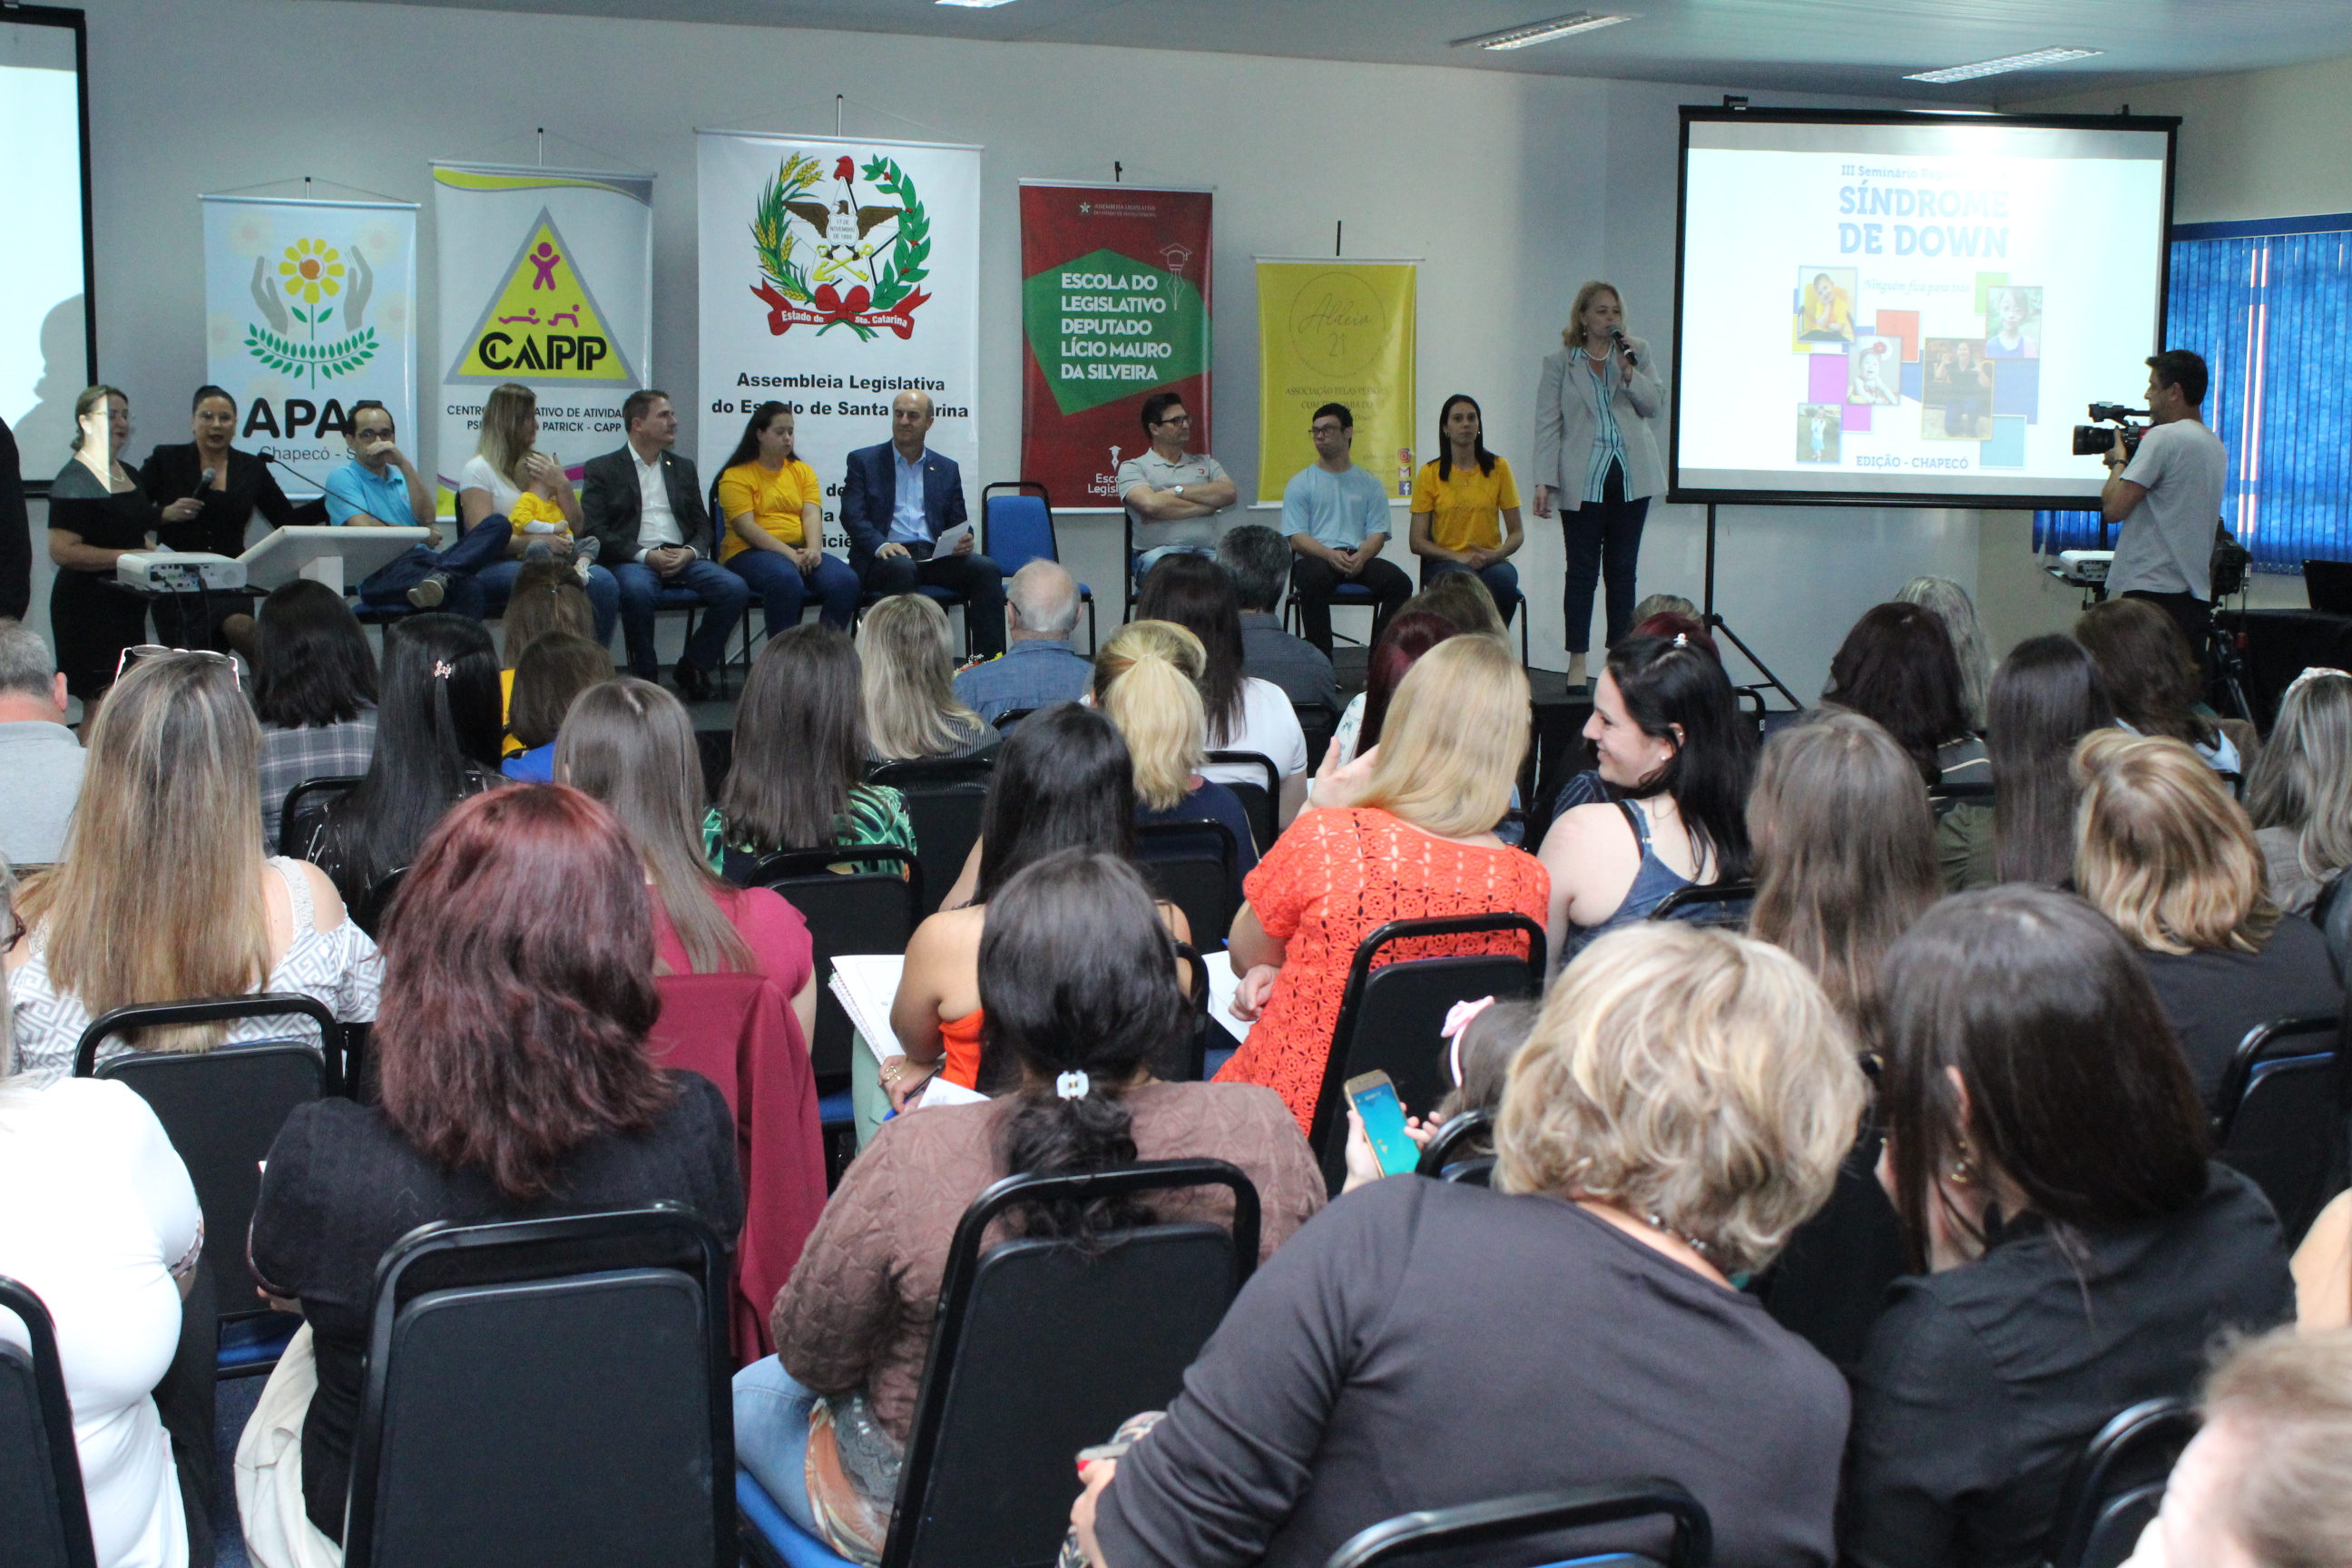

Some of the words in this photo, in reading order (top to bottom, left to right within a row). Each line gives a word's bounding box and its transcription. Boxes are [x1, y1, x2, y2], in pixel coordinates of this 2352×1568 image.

[1841, 165, 1855, 176] III
[1858, 165, 1917, 180] Seminário
[1839, 180, 2009, 218] SÍNDROME
[1838, 222, 1883, 254] DE
[1894, 224, 2009, 258] DOWN
[1062, 273, 1129, 289] ESCOLA
[1132, 275, 1158, 290] DO
[1862, 279, 1906, 294] Ninguém
[1906, 279, 1926, 295] fica
[1927, 282, 1949, 296] para
[1062, 296, 1166, 313] LEGISLATIVO
[1298, 292, 1372, 334] Aldeia
[781, 310, 811, 321] Estado
[813, 314, 824, 322] de
[855, 315, 870, 324] Sta.
[872, 315, 907, 328] Catarina
[1062, 318, 1152, 335] DEPUTADO
[479, 331, 607, 370] CAPP
[1062, 337, 1107, 357] LÍCIO
[1109, 342, 1171, 358] MAURO
[1329, 332, 1345, 357] 21
[1062, 363, 1085, 379] DA
[1087, 364, 1158, 380] SILVEIRA
[737, 372, 844, 388] Assembleia
[849, 375, 946, 392] Legislativa
[1285, 387, 1333, 397] ASSOCIAÇÃO
[534, 407, 564, 417] ATIVO
[567, 408, 581, 417] DE
[583, 408, 624, 418] ATIVIDA
[711, 399, 734, 413] do
[810, 401, 832, 416] de
[838, 402, 889, 416] Santa
[242, 397, 383, 439] APA
[543, 422, 583, 432] PATRICK
[594, 423, 622, 432] CAPP
[1856, 454, 1901, 469] EDIÇÃO
[1911, 456, 1969, 469] CHAPECÓ
[1095, 473, 1119, 484] Esco
[1087, 484, 1119, 496] Legisl
